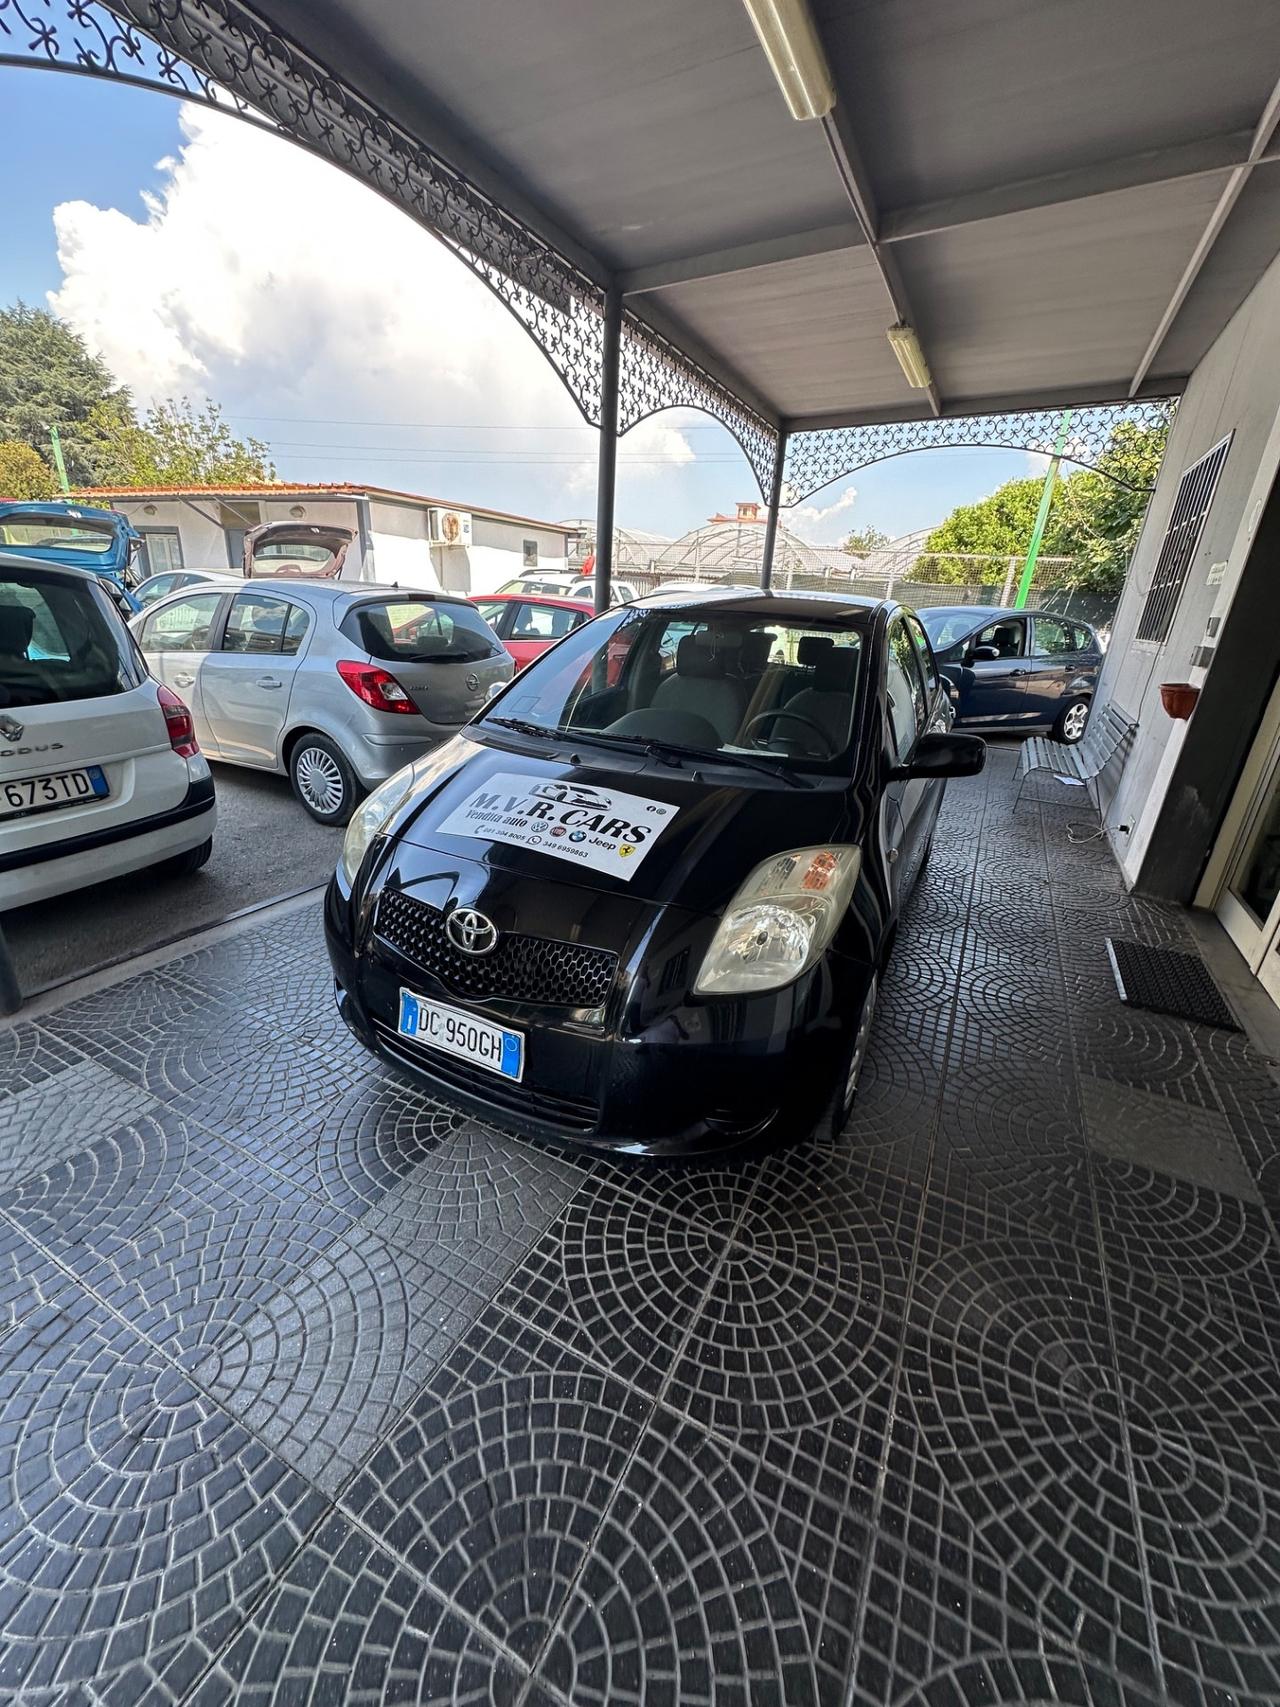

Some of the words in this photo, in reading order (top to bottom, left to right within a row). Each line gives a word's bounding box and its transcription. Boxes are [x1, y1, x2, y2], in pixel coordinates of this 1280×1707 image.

[4, 772, 90, 808] 673TD
[466, 809, 503, 823] Vendita
[502, 816, 528, 828] auto
[588, 837, 617, 850] Jeep
[419, 1008, 440, 1035] DC
[446, 1018, 501, 1062] 950GH
